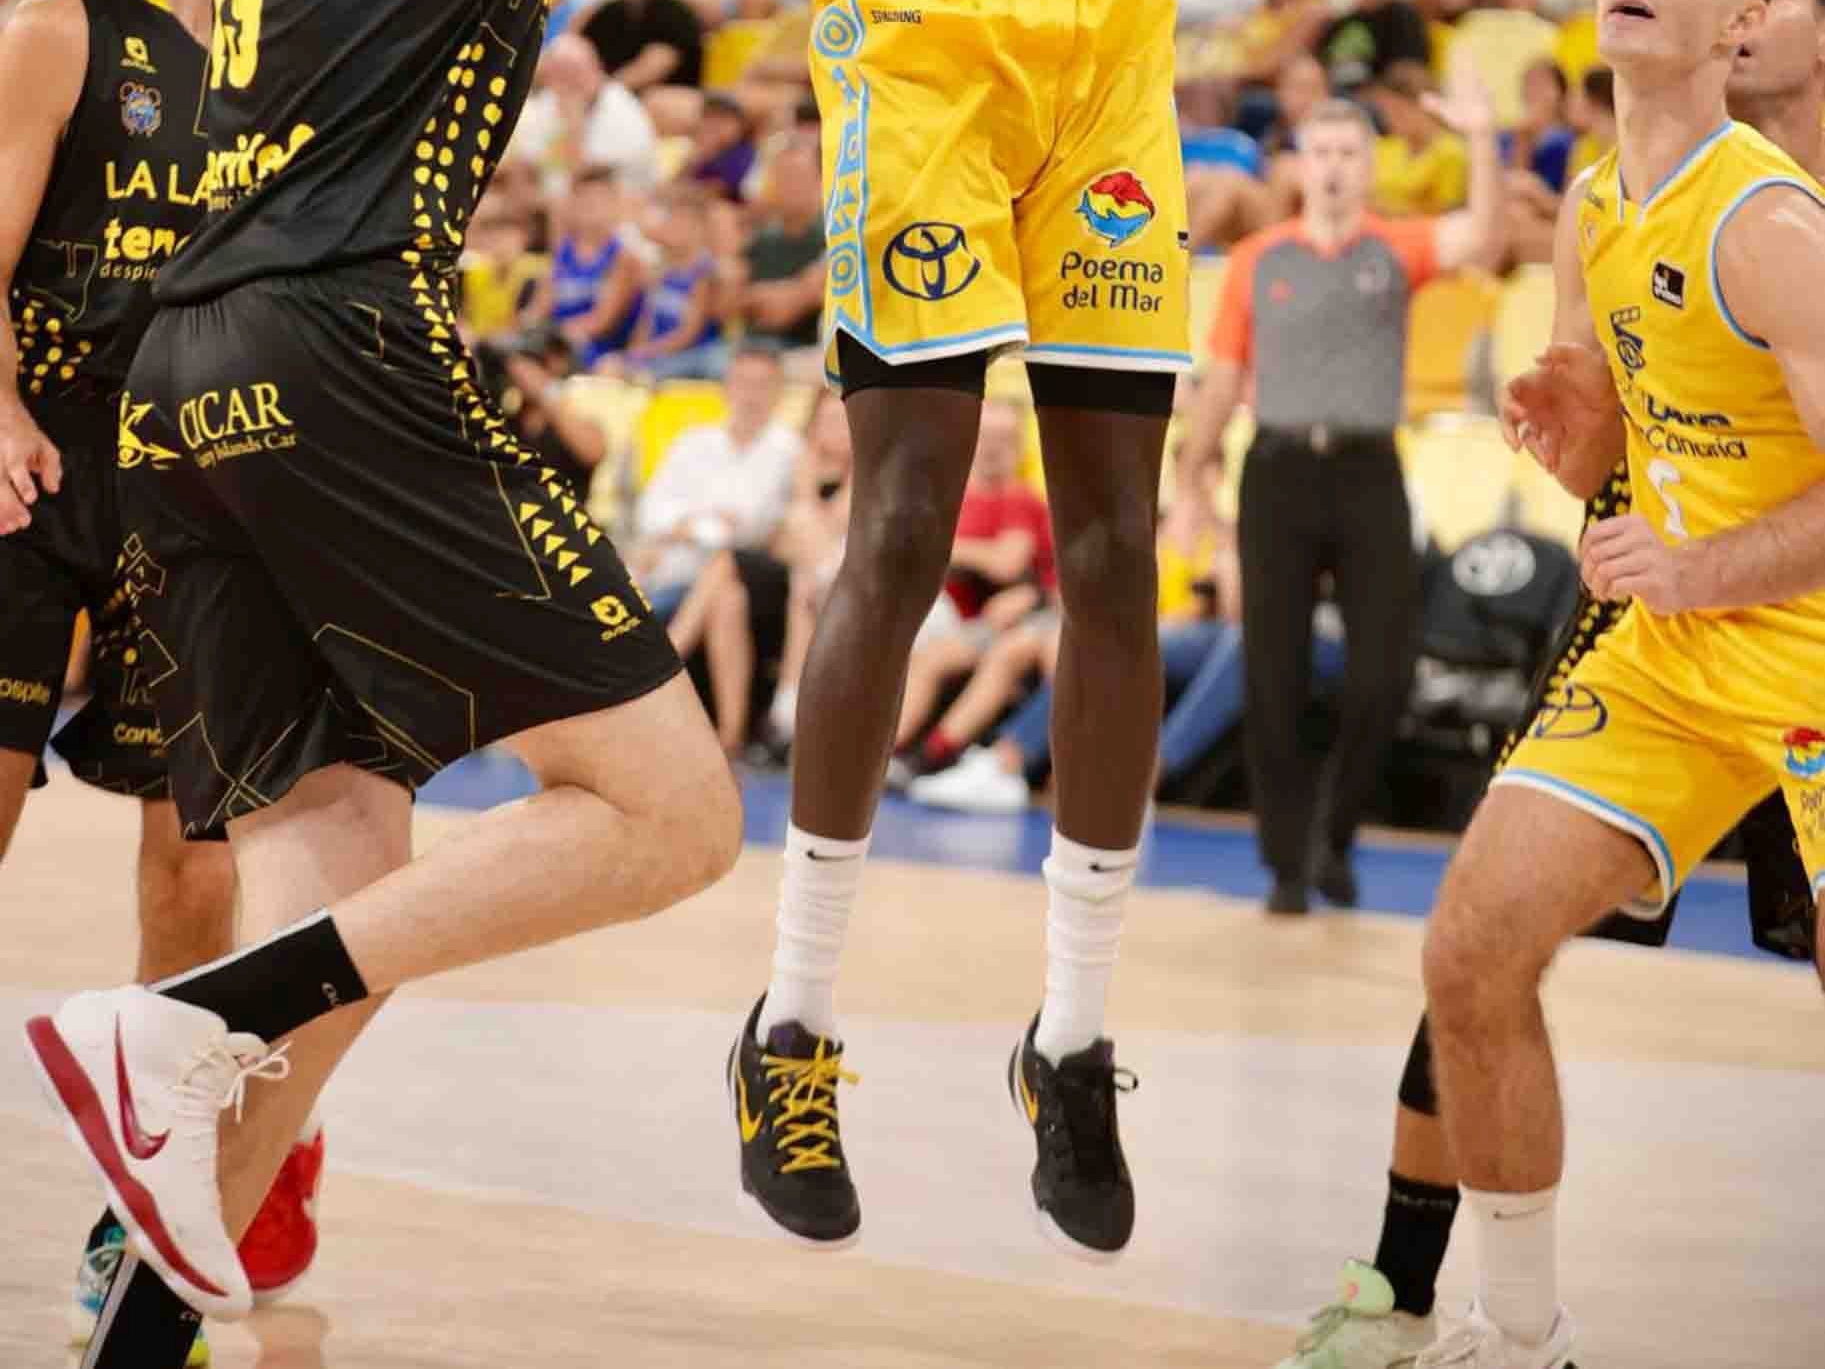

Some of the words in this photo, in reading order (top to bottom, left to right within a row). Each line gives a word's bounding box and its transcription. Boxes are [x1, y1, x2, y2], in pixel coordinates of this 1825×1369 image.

[105, 159, 158, 201] LA
[103, 216, 193, 261] ten
[1060, 251, 1164, 283] Poema
[1062, 282, 1099, 310] del
[1108, 283, 1163, 312] Mar
